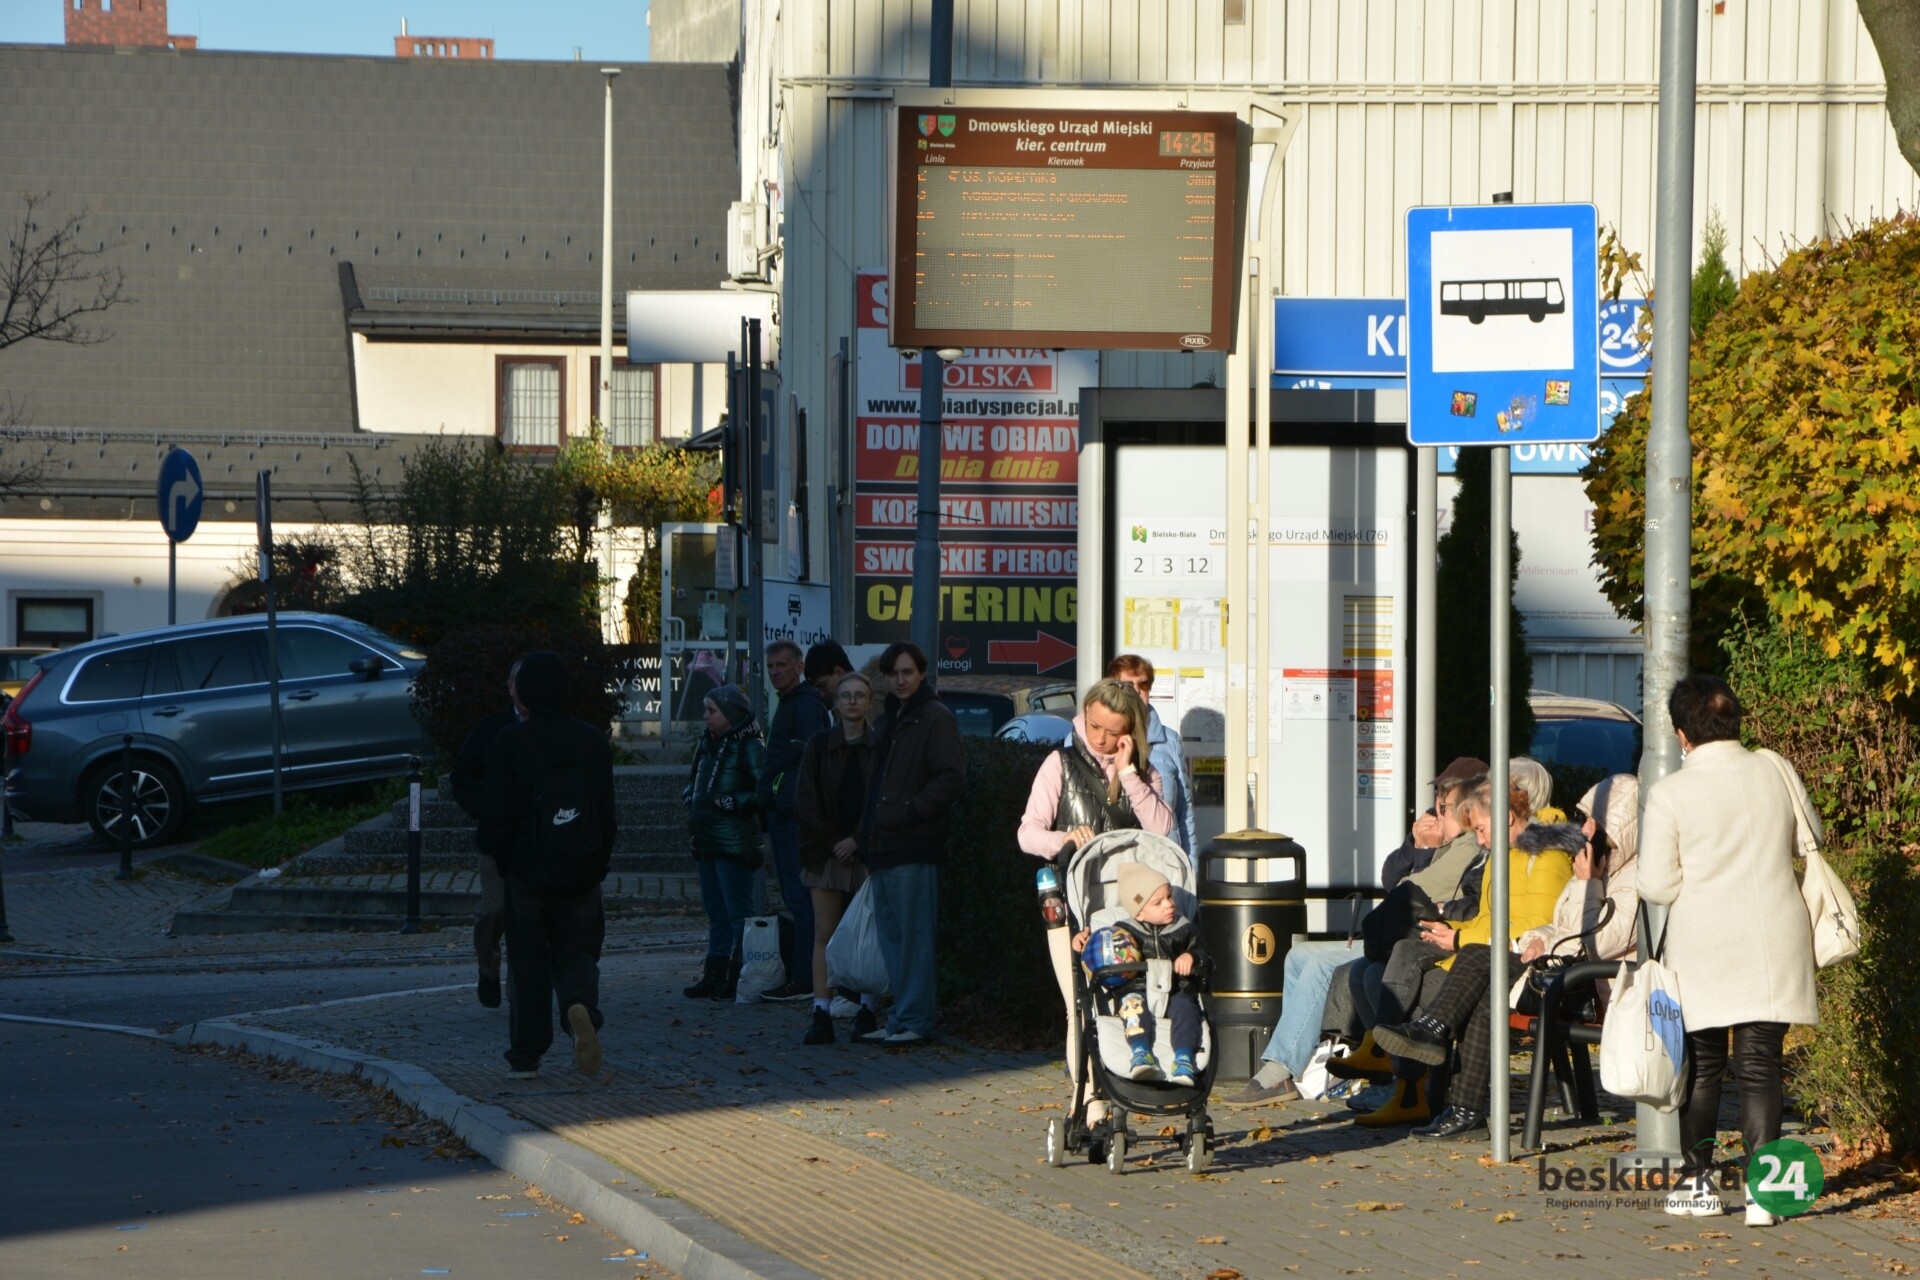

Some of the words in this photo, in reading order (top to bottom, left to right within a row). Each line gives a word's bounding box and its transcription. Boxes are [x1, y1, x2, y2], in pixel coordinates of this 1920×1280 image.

[968, 118, 1055, 135] Dmowskiego
[1059, 120, 1098, 136] Urząd
[1102, 121, 1153, 137] Miejski
[1016, 138, 1046, 152] kier.
[1050, 140, 1107, 152] centrum
[1162, 132, 1215, 154] 14:25
[925, 154, 945, 163] Linia
[1048, 156, 1084, 166] Kierunek
[1180, 159, 1215, 169] Przyjazd
[1185, 337, 1206, 345] PIXEL
[1602, 322, 1640, 350] 24
[943, 365, 1035, 387] OLSKA
[866, 424, 984, 452] DOMWE
[895, 455, 985, 478] Dnia
[990, 456, 1059, 479] dnia
[990, 500, 1078, 528] MIĘSNE
[1209, 529, 1282, 542] Dmskgo
[1286, 530, 1319, 541] Urząd
[1322, 529, 1362, 542] Miejski
[1366, 530, 1388, 542] (76)
[863, 547, 986, 573] SWSKIE
[992, 549, 1078, 573] PIEROG
[1133, 557, 1144, 573] 2
[1162, 557, 1173, 574] 3
[1187, 557, 1209, 574] 12
[631, 674, 682, 692] ŚWIT
[557, 807, 577, 819] NIKE
